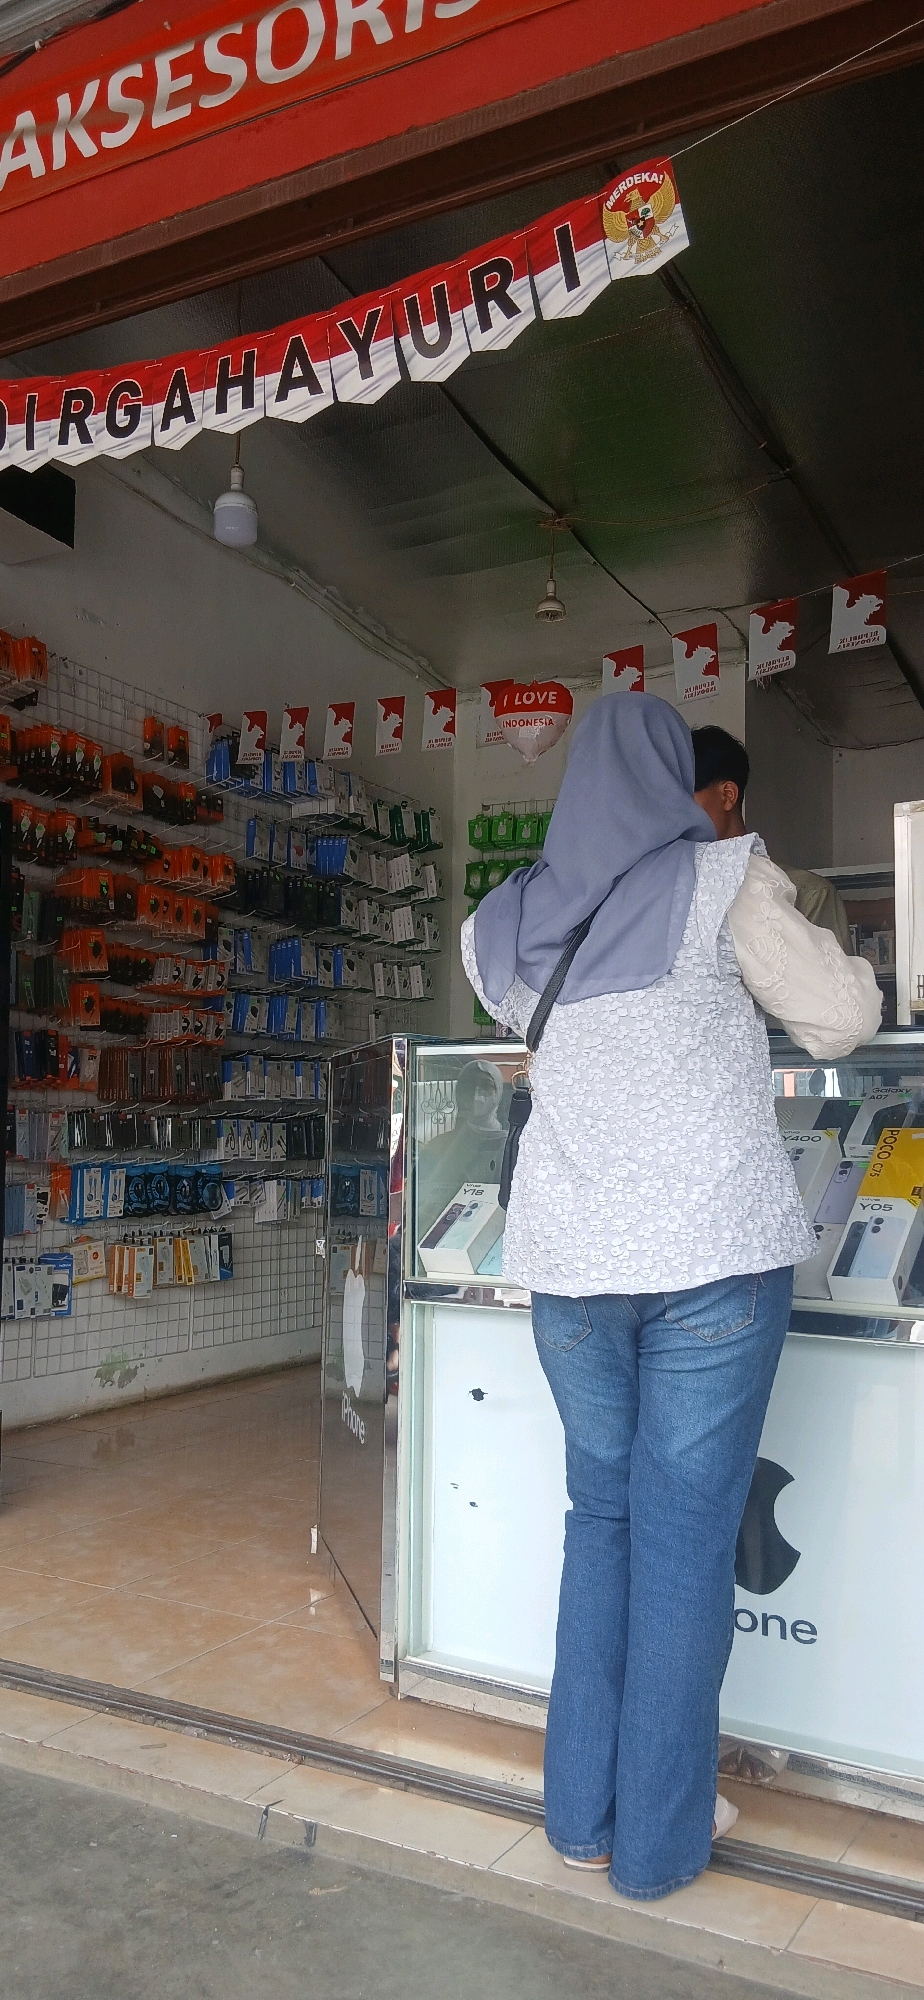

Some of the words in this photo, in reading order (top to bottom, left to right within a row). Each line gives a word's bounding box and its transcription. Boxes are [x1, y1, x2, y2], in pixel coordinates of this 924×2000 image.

[0, 0, 480, 192] AKSESORI
[605, 171, 664, 210] MERDEKA!
[503, 694, 508, 708] I
[514, 691, 558, 706] LOVE
[502, 718, 555, 729] INDONESIA
[877, 1129, 901, 1160] POCO
[869, 1163, 884, 1177] C75
[859, 1202, 893, 1211] Y05
[341, 1390, 365, 1445] iPhone
